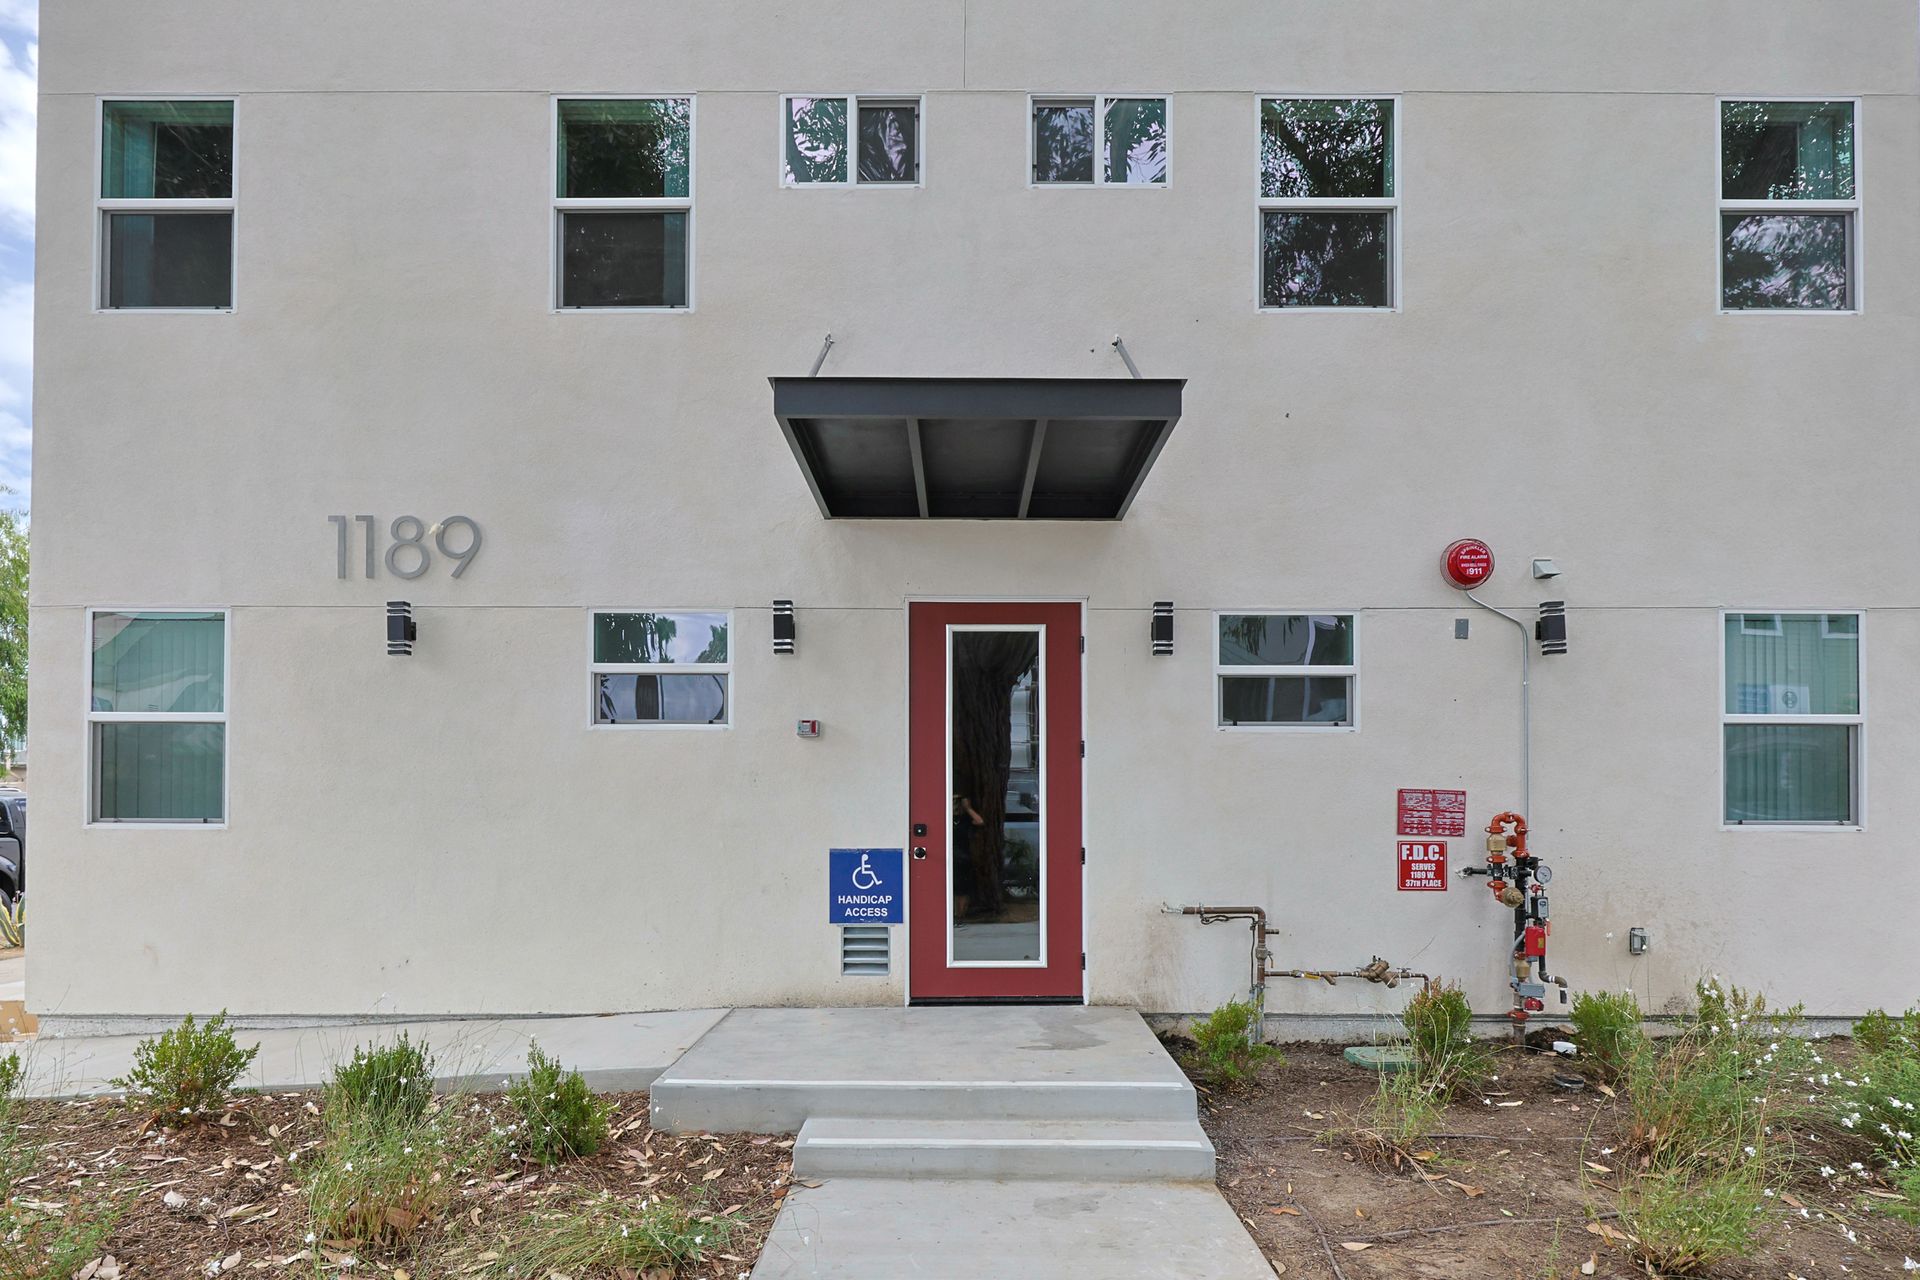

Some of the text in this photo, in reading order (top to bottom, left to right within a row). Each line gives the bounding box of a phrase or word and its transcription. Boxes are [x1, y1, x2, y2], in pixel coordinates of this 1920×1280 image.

[327, 515, 482, 580] 1189
[1469, 567, 1482, 575] 911
[1401, 844, 1444, 860] F.D.C.
[1411, 863, 1436, 871] SERVES
[1410, 871, 1436, 879] 1189 W.
[1421, 879, 1442, 887] PLACE
[837, 895, 892, 904] HANDICAP
[844, 907, 888, 917] ACCESS
